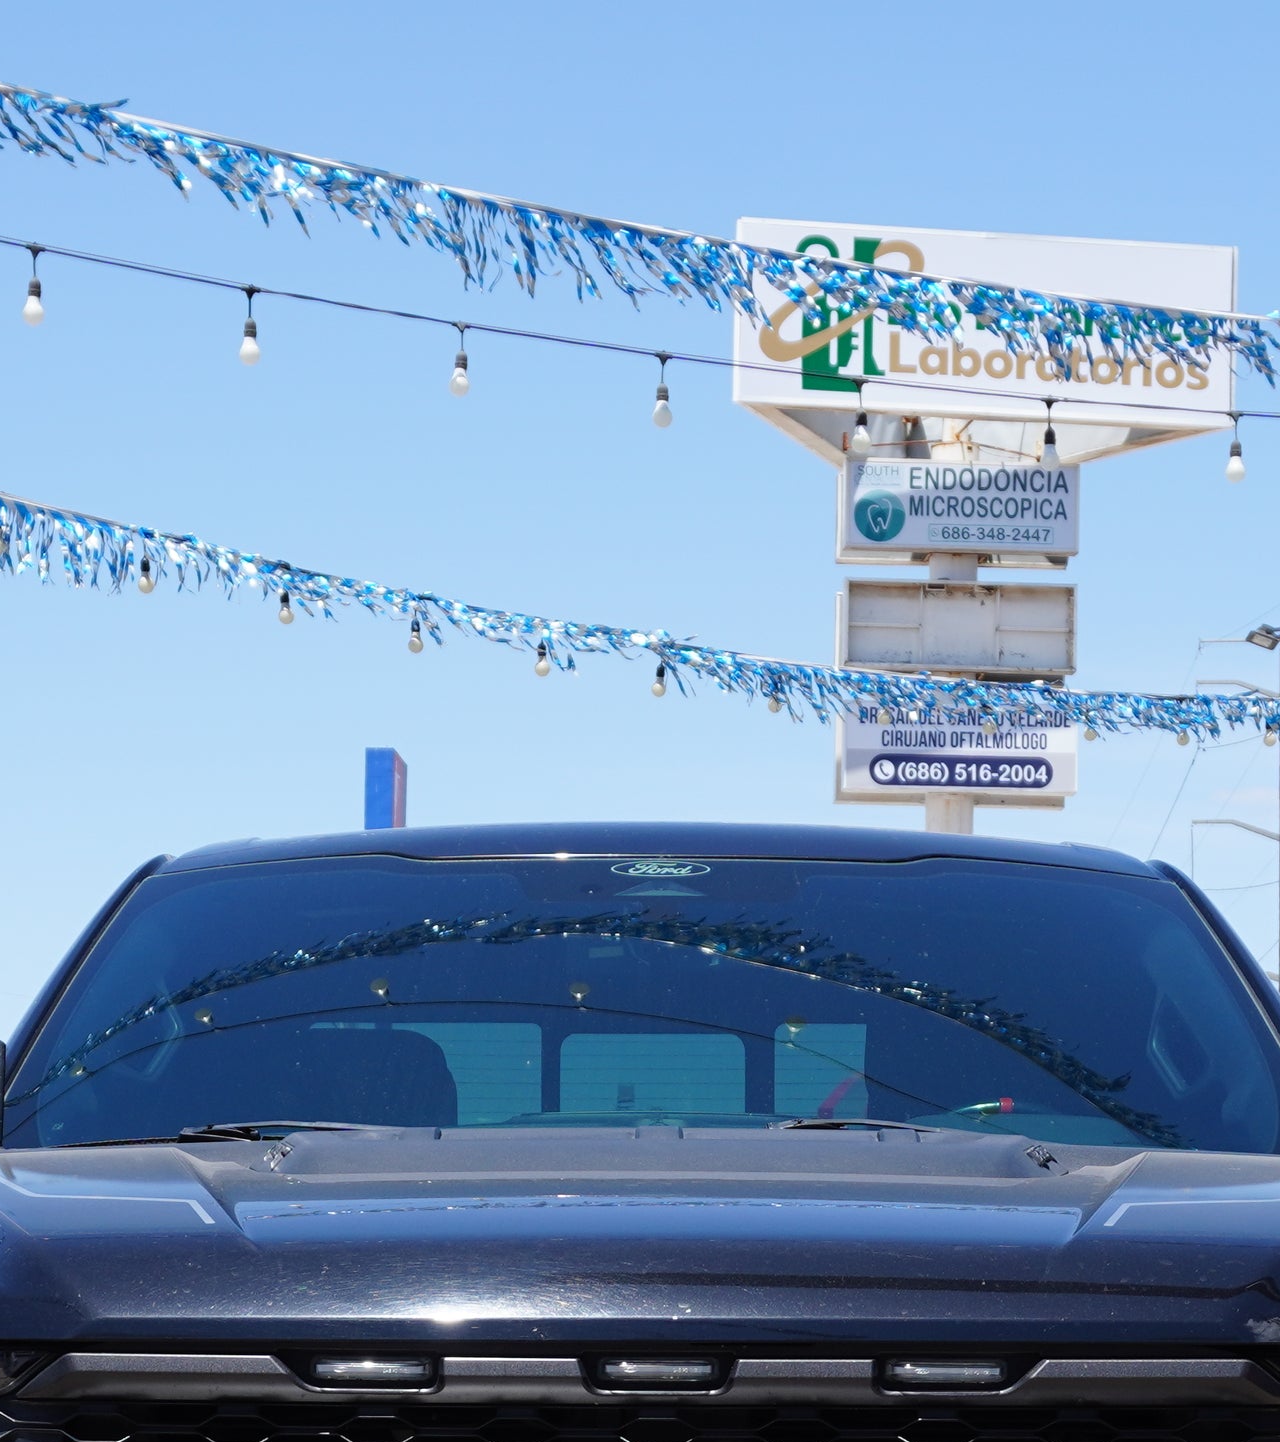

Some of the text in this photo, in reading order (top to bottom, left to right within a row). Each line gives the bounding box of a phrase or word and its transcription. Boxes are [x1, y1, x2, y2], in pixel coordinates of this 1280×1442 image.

[857, 464, 900, 477] SOUTH
[909, 466, 1069, 494] ENDODONCIA
[909, 494, 1068, 521] MICROSCOPICA
[941, 526, 1051, 543] 686-348-2447
[881, 729, 1048, 750] CIRUJANO OFTALMÓLOGO
[897, 761, 1048, 784] (686) 516-2004
[628, 862, 692, 875] Ford
